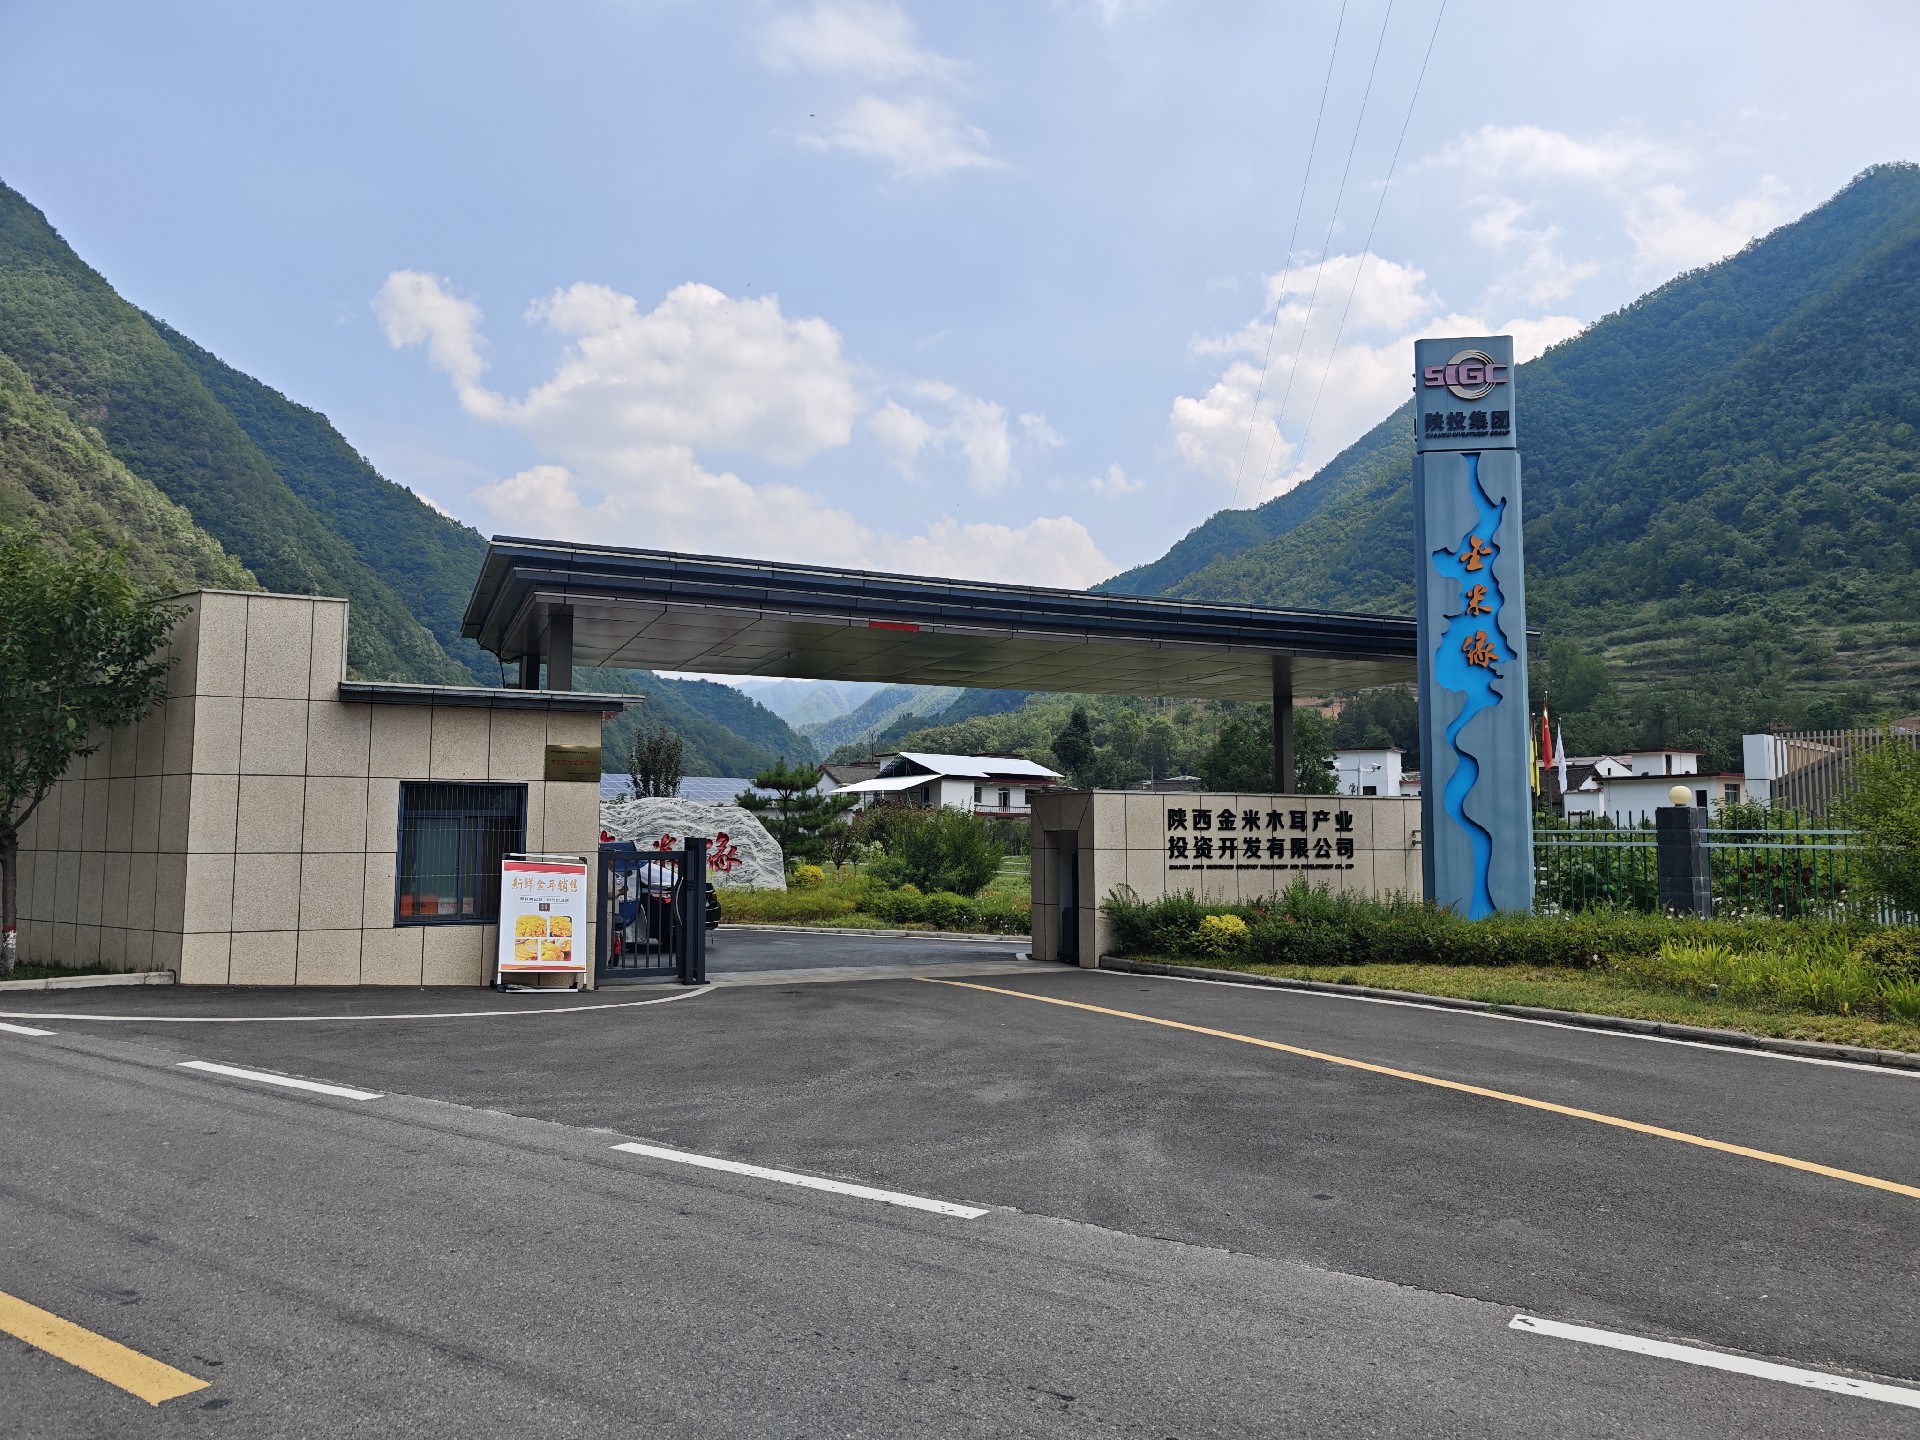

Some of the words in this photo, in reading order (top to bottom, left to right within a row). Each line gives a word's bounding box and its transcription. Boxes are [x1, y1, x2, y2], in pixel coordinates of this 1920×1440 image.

[1425, 410, 1510, 431] 陕投集团
[1167, 808, 1354, 832] 陕西金米木耳产业
[1168, 835, 1354, 860] 投资开发有限公司
[511, 877, 578, 892] 新鲜金耳销售
